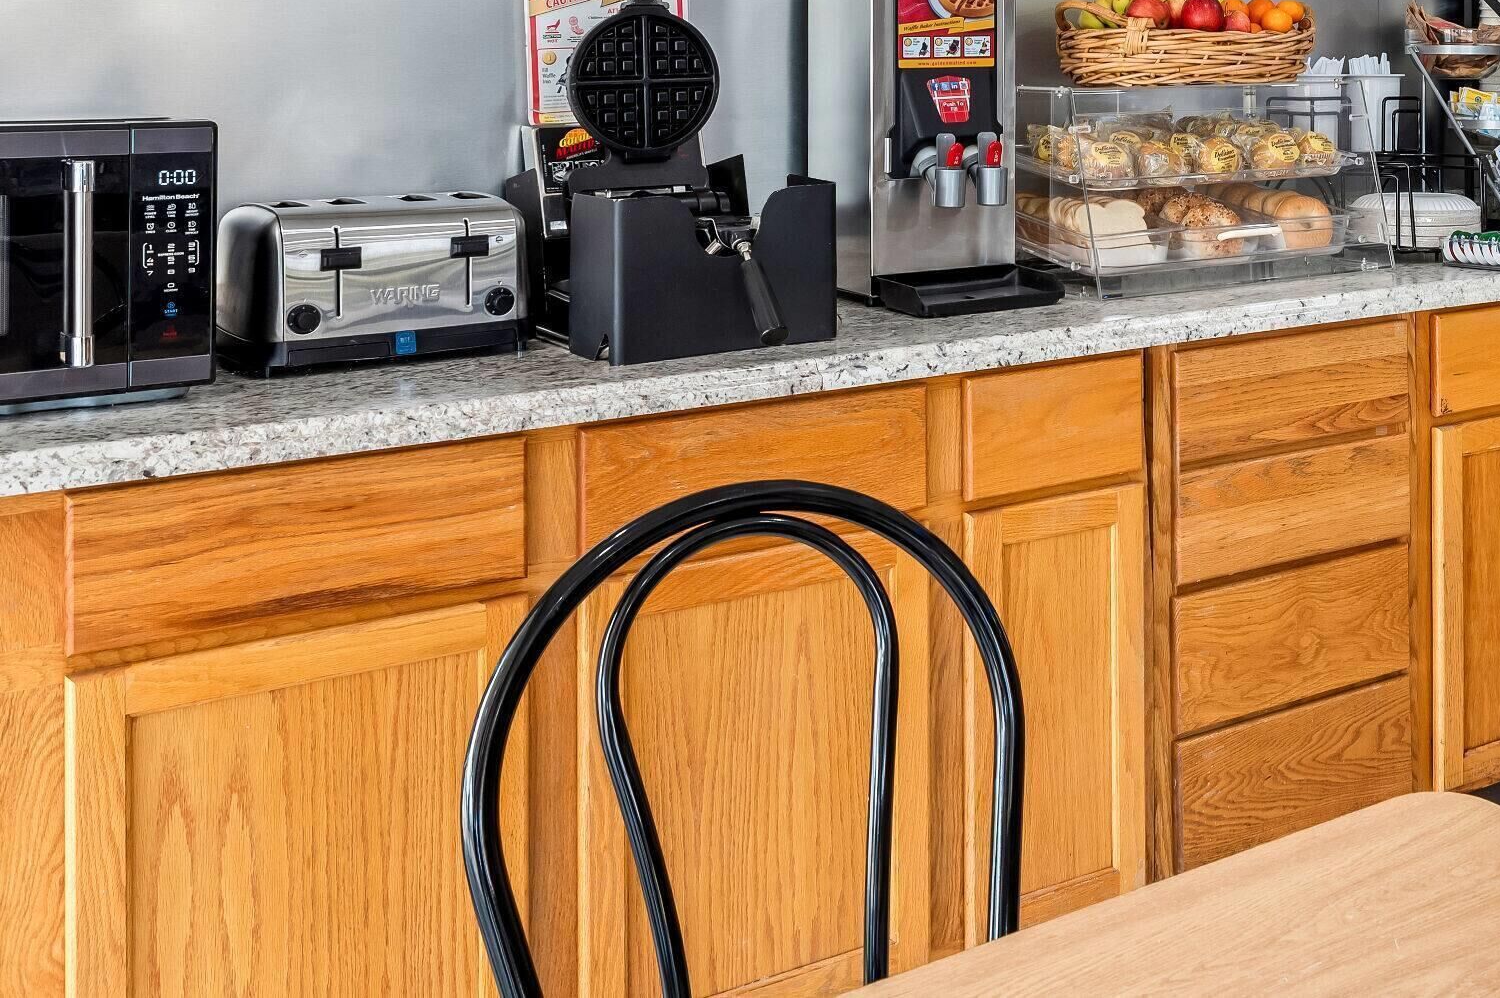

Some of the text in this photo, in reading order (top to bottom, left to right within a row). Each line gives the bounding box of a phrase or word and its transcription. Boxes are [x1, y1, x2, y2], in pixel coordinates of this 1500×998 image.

[158, 169, 197, 186] 0:00
[142, 194, 176, 202] Hamilton
[369, 283, 441, 307] WARING
